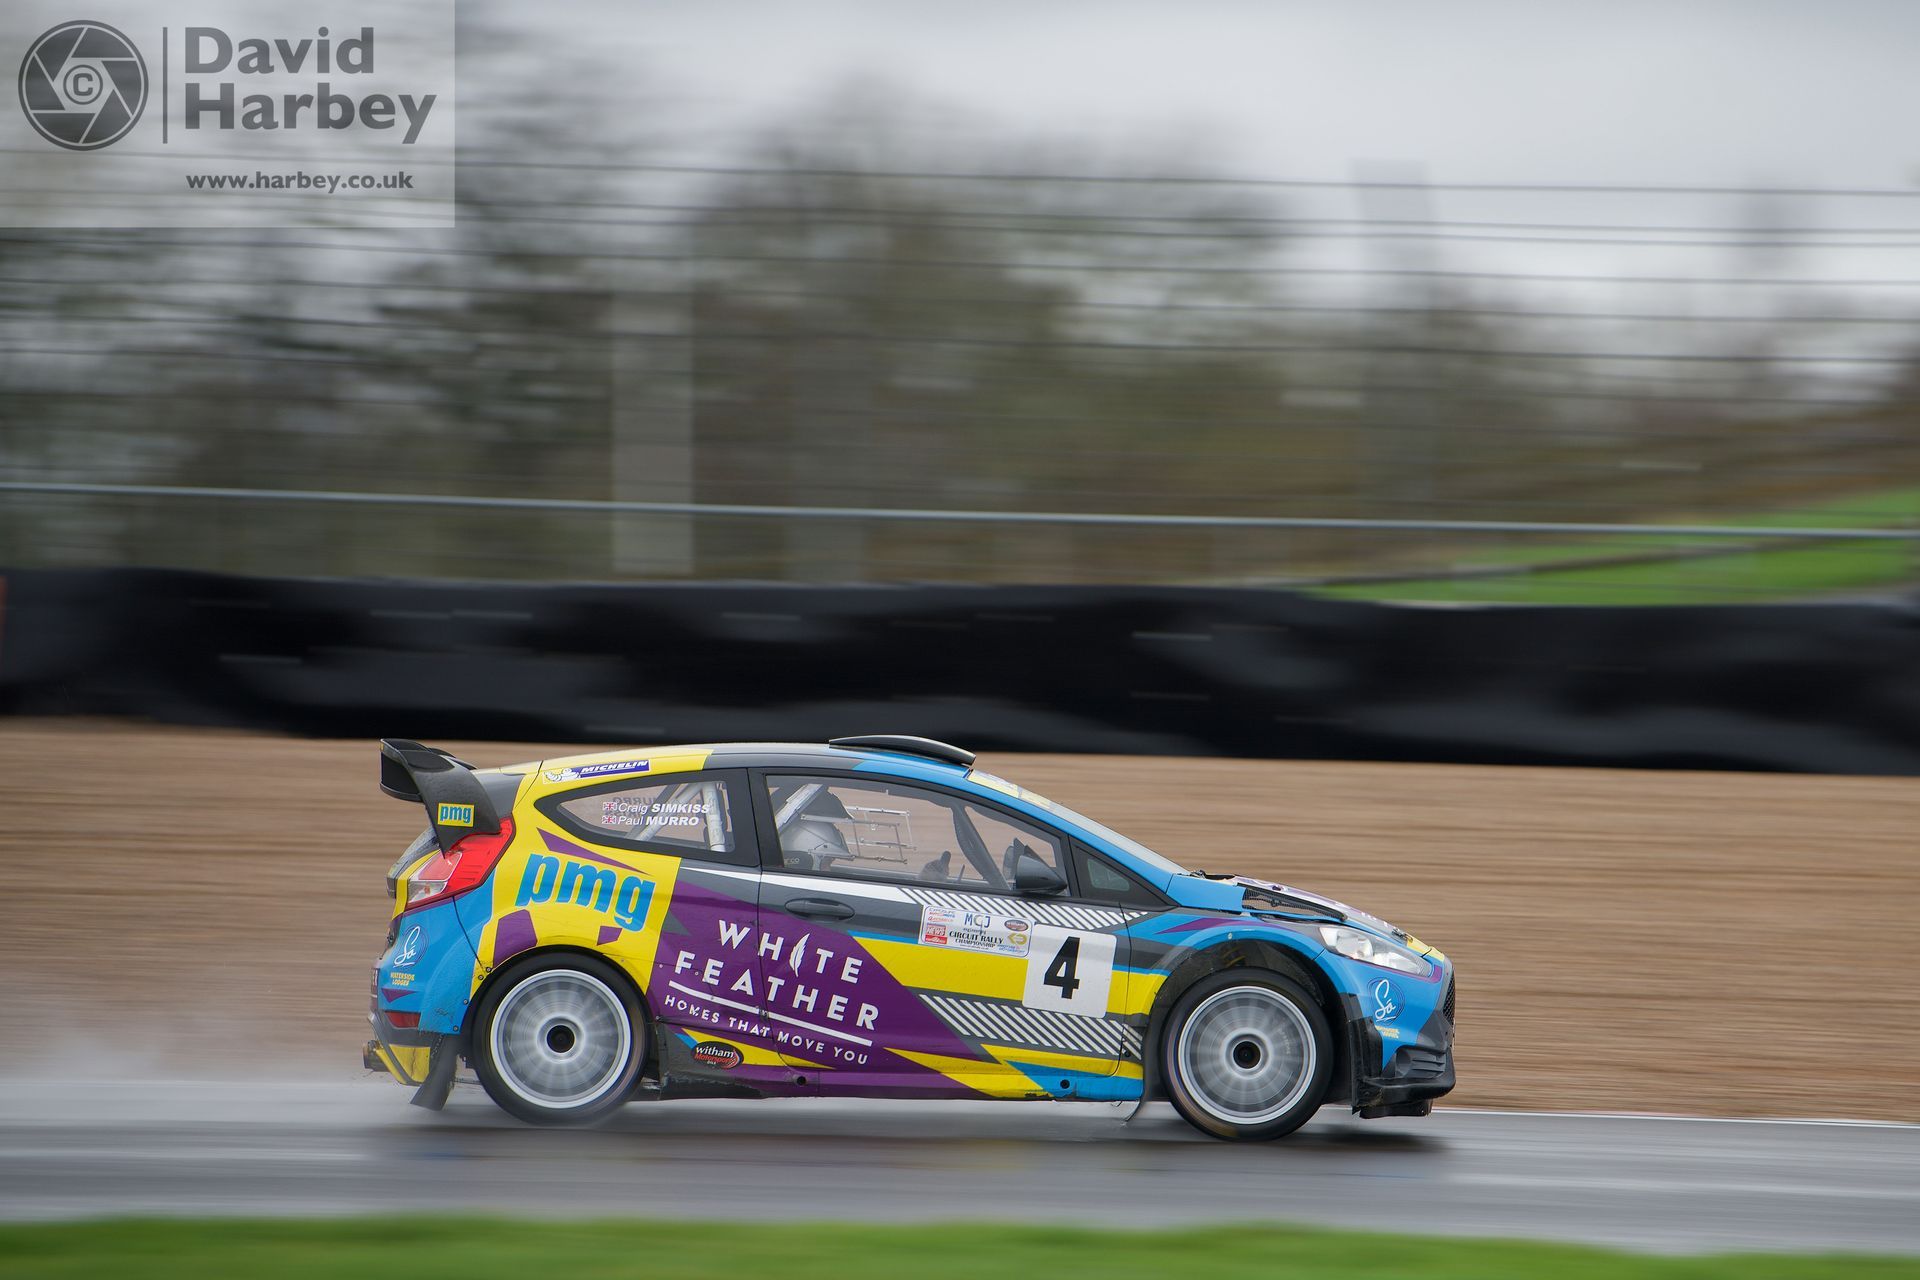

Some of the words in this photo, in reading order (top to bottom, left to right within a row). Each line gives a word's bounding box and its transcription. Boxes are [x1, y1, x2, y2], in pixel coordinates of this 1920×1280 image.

[581, 760, 649, 773] MICHELIN
[439, 805, 473, 824] pmg
[618, 802, 649, 814] Craig
[651, 803, 711, 814] SIMKISS
[617, 815, 644, 826] Paul
[645, 816, 700, 826] MURRO
[514, 853, 657, 933] pmg
[949, 930, 979, 941] CIRCUIT
[980, 934, 1005, 945] RALLY
[955, 938, 996, 948] CHAMPIONSHIP
[1043, 935, 1081, 1000] 4
[674, 950, 880, 1031] FEATHER
[664, 994, 720, 1023] HOMES
[729, 1016, 771, 1037] THAT
[777, 1030, 826, 1054] MOVE
[833, 1046, 869, 1066] YOU
[695, 1045, 735, 1058] witham
